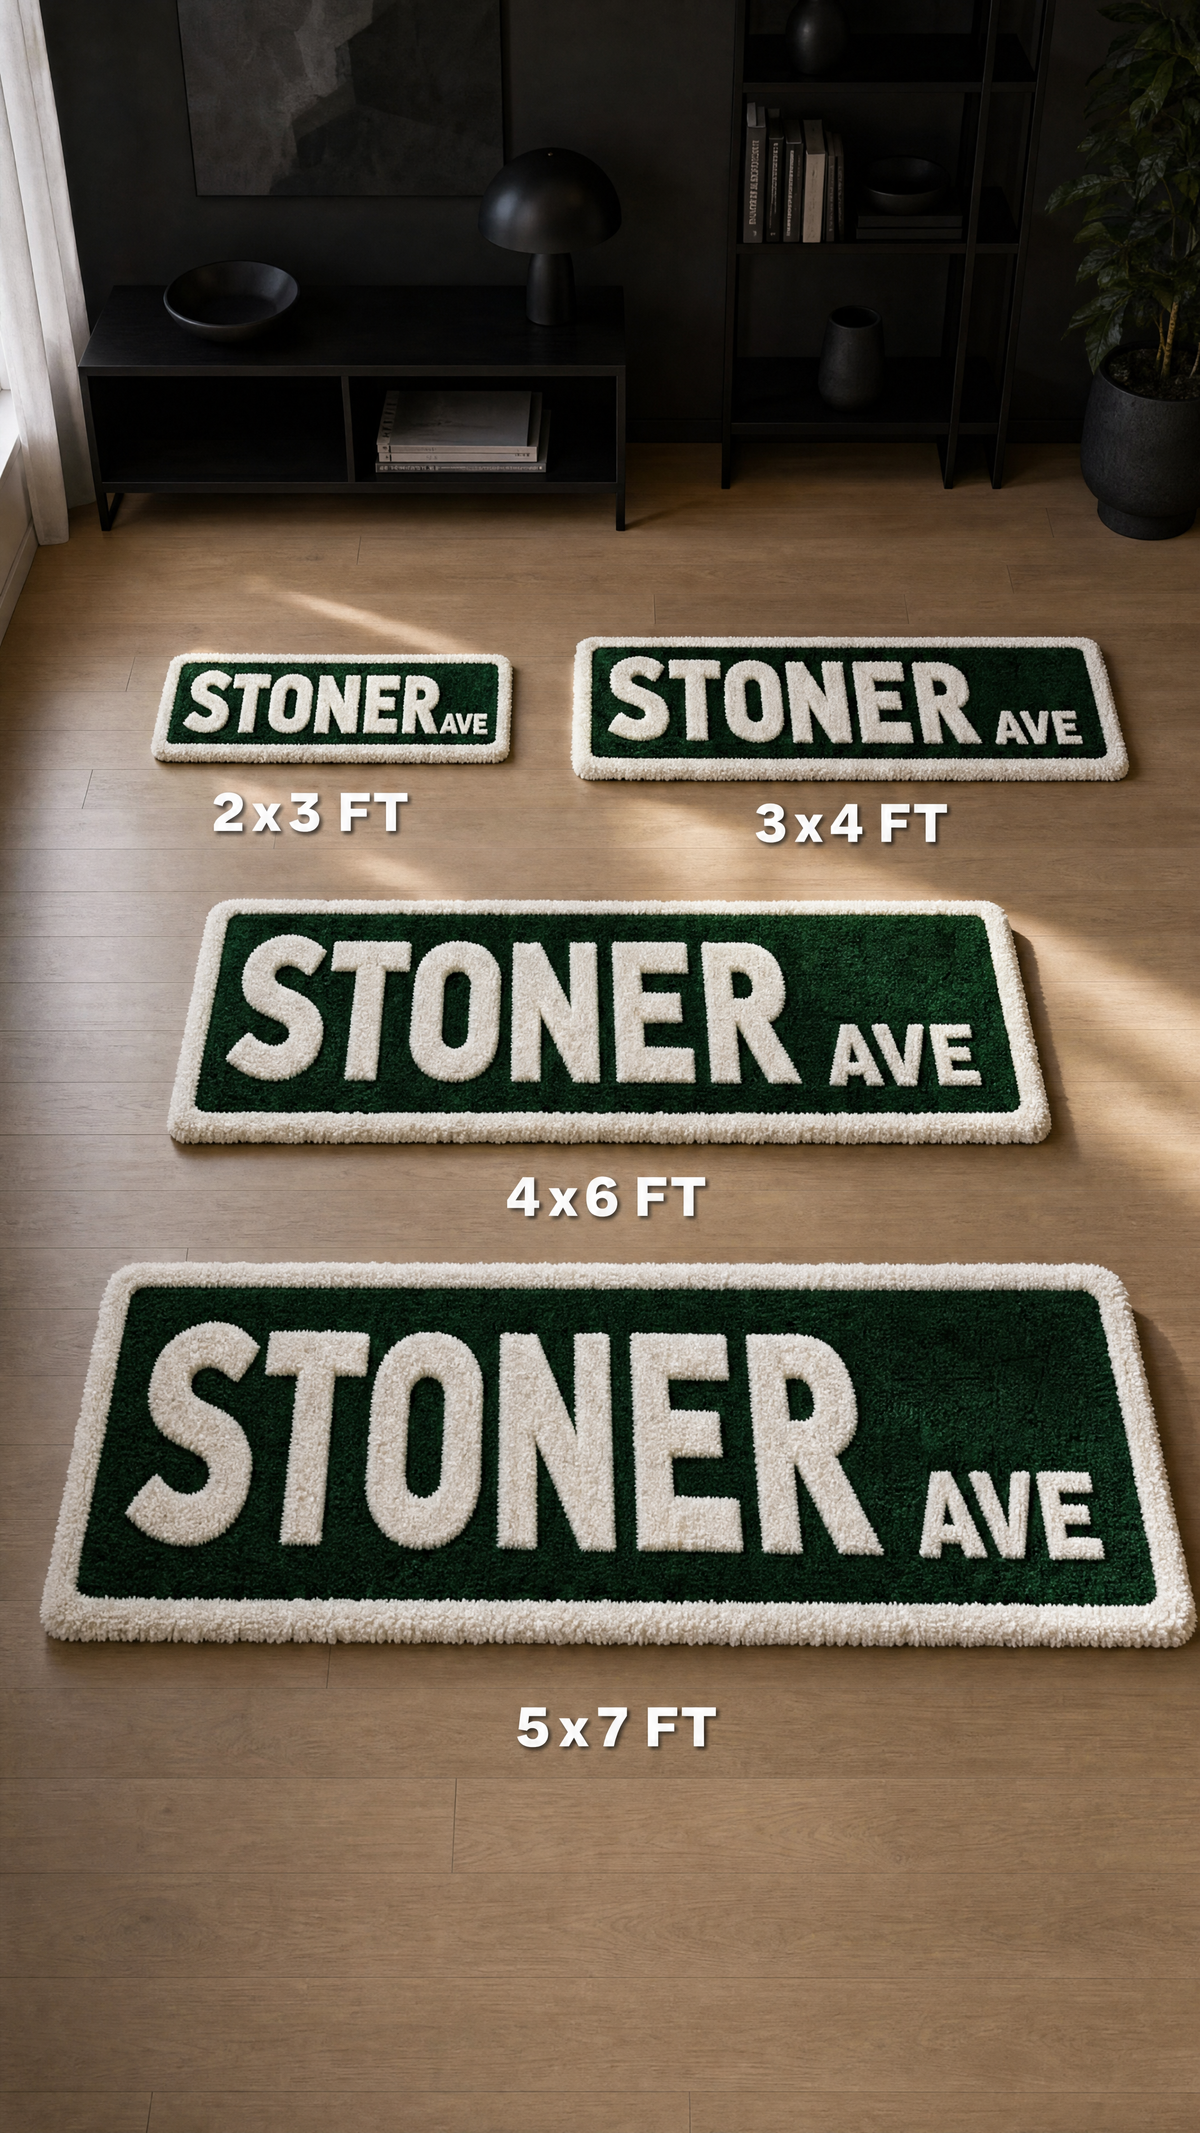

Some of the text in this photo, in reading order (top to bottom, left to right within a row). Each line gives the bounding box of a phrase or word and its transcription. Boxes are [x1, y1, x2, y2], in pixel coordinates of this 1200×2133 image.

[183, 669, 488, 735] STONER AVE
[608, 655, 1083, 745] STONER AVE
[226, 934, 982, 1087] STONER AVE
[125, 1321, 1104, 1561] STONER AVE
